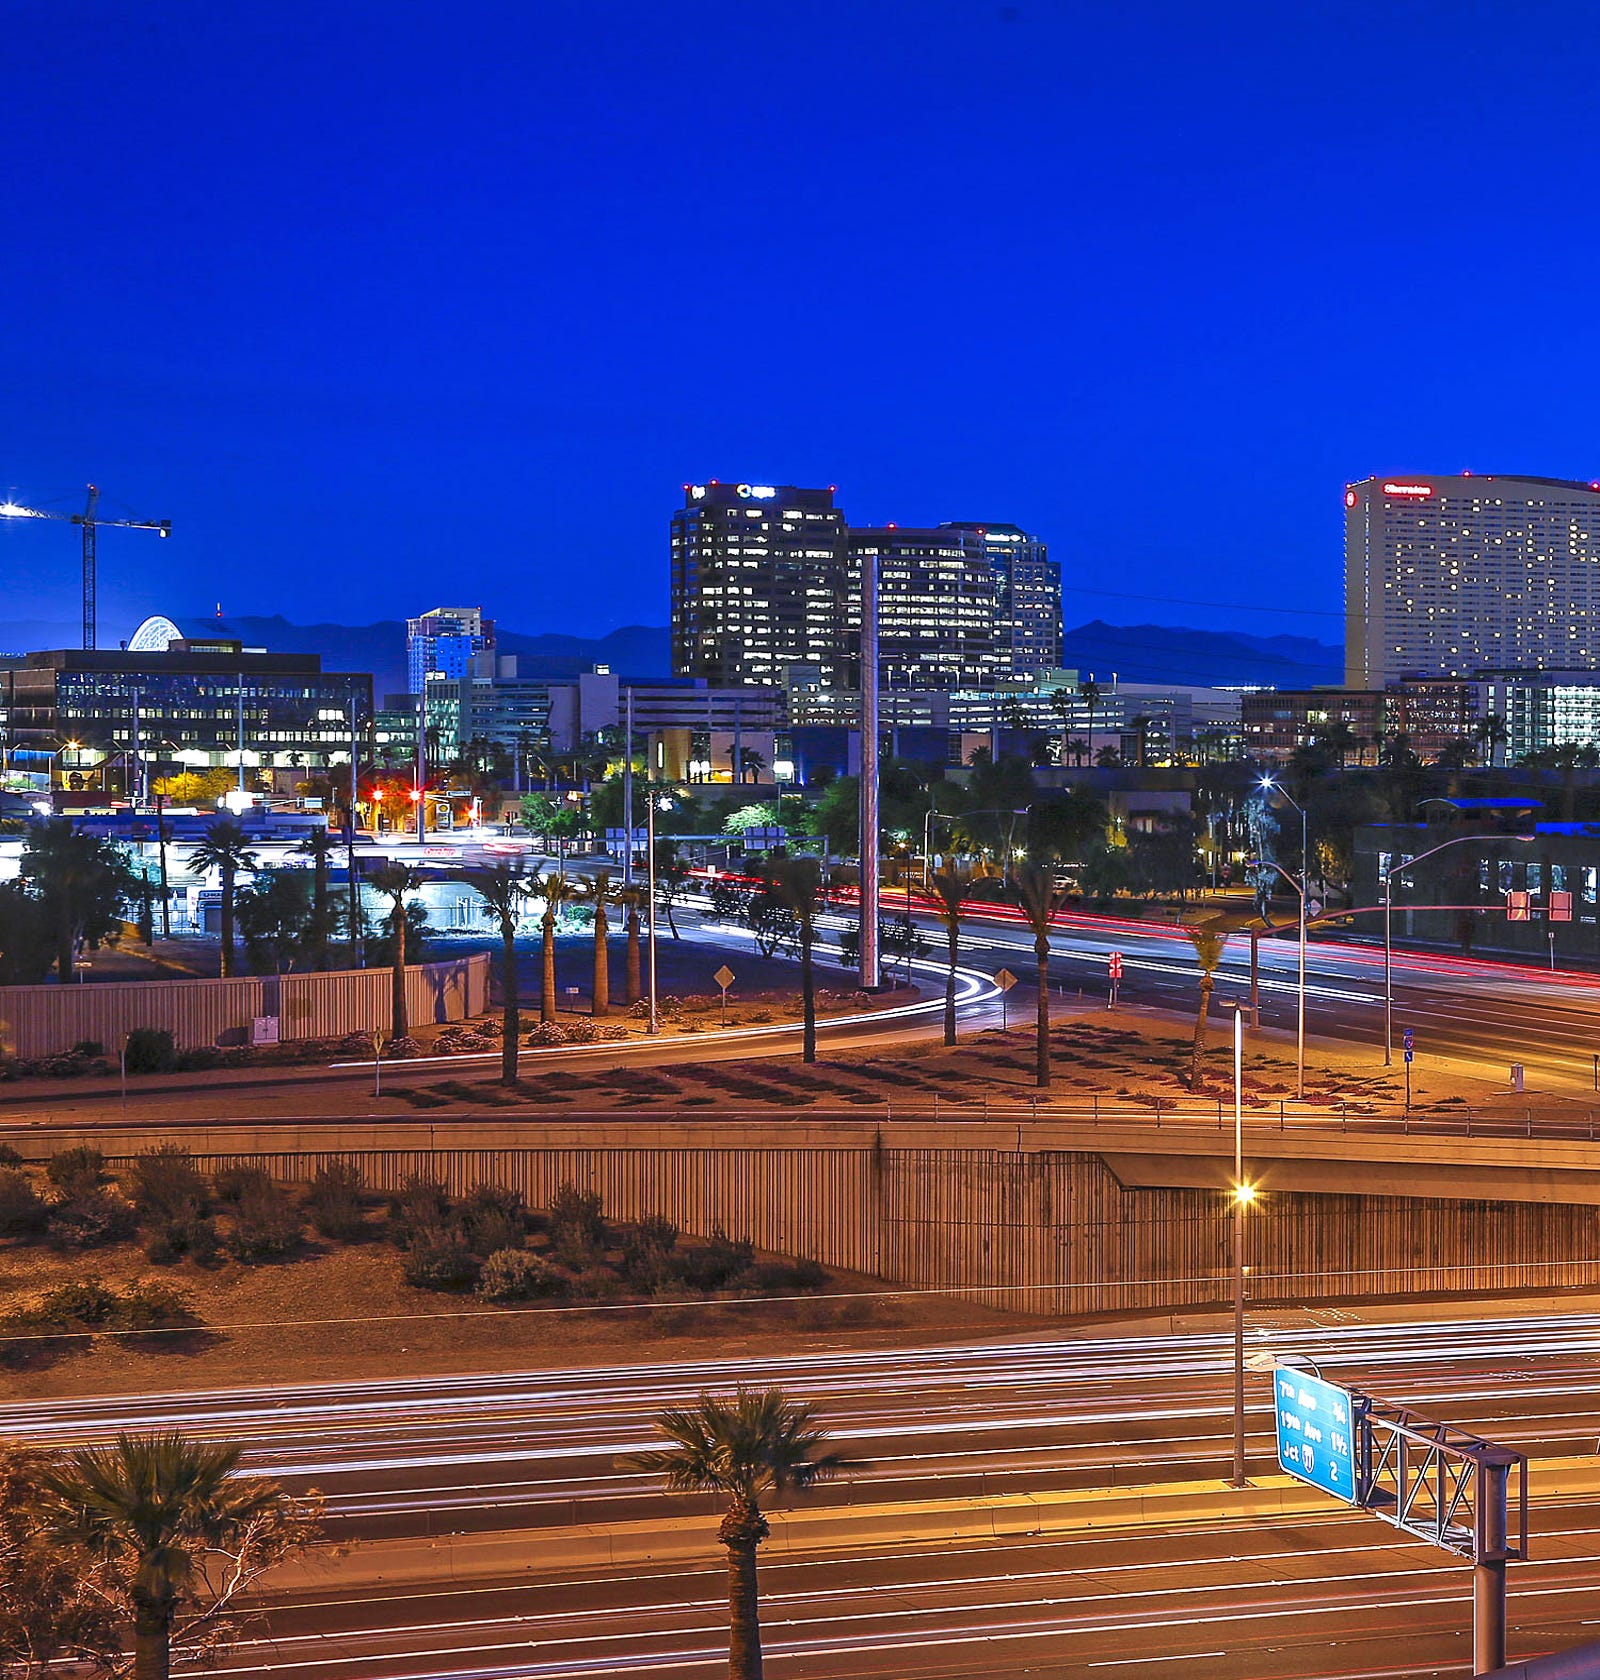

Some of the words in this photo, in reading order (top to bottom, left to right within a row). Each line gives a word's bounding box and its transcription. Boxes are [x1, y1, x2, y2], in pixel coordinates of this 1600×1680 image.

[1278, 1380, 1296, 1399] 7th
[1280, 1410, 1301, 1430] 19th
[1303, 1420, 1322, 1443] Ave
[1283, 1440, 1299, 1462] Jct
[1329, 1460, 1339, 1481] 2
